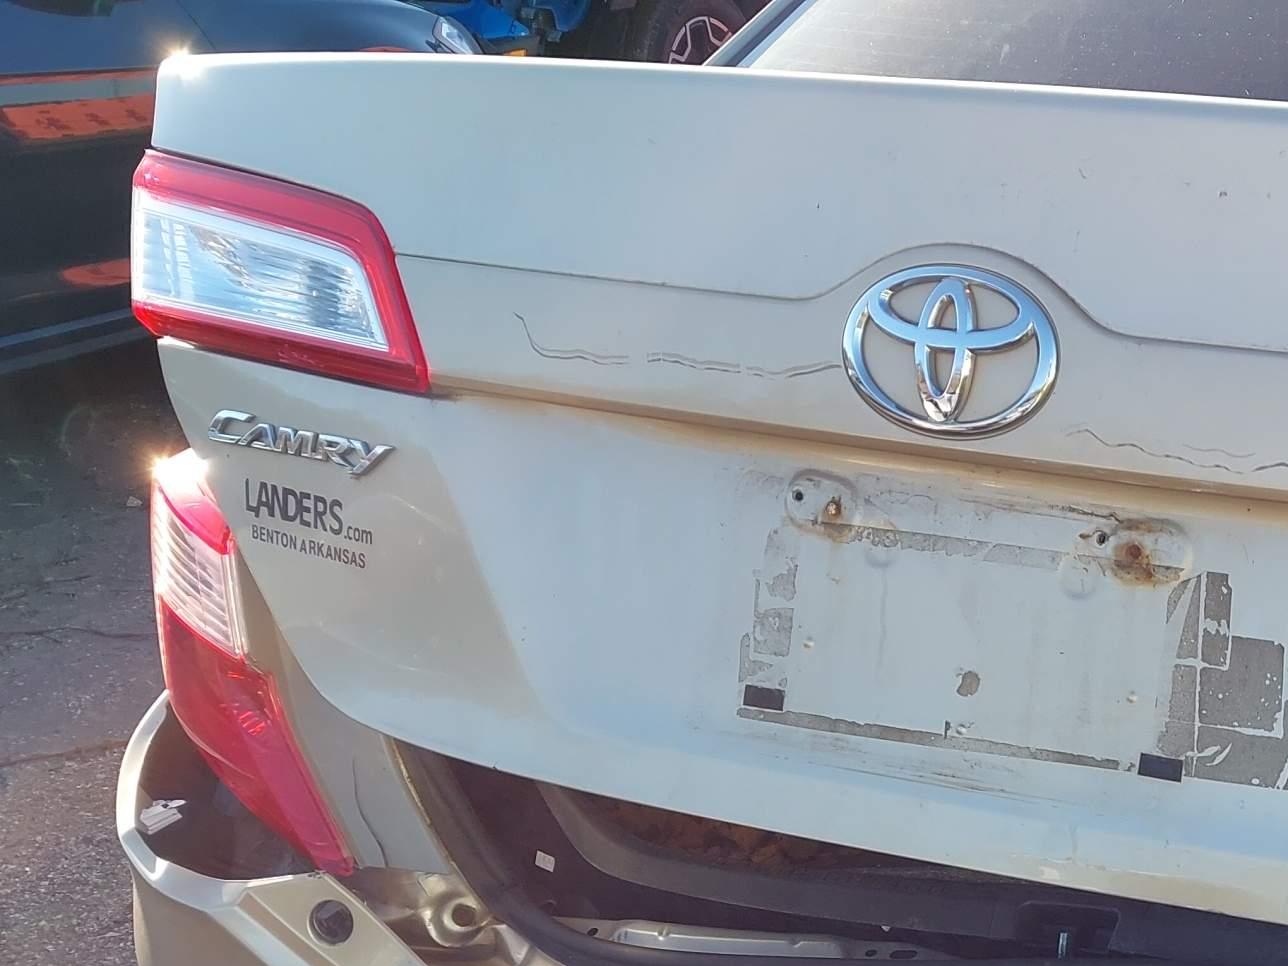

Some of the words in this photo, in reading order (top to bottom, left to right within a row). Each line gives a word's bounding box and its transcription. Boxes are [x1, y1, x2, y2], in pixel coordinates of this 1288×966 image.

[208, 409, 396, 476] CAMRY
[245, 477, 373, 545] LANDERS.com
[252, 524, 297, 550] BENTON
[299, 539, 366, 569] ARKANSAS
